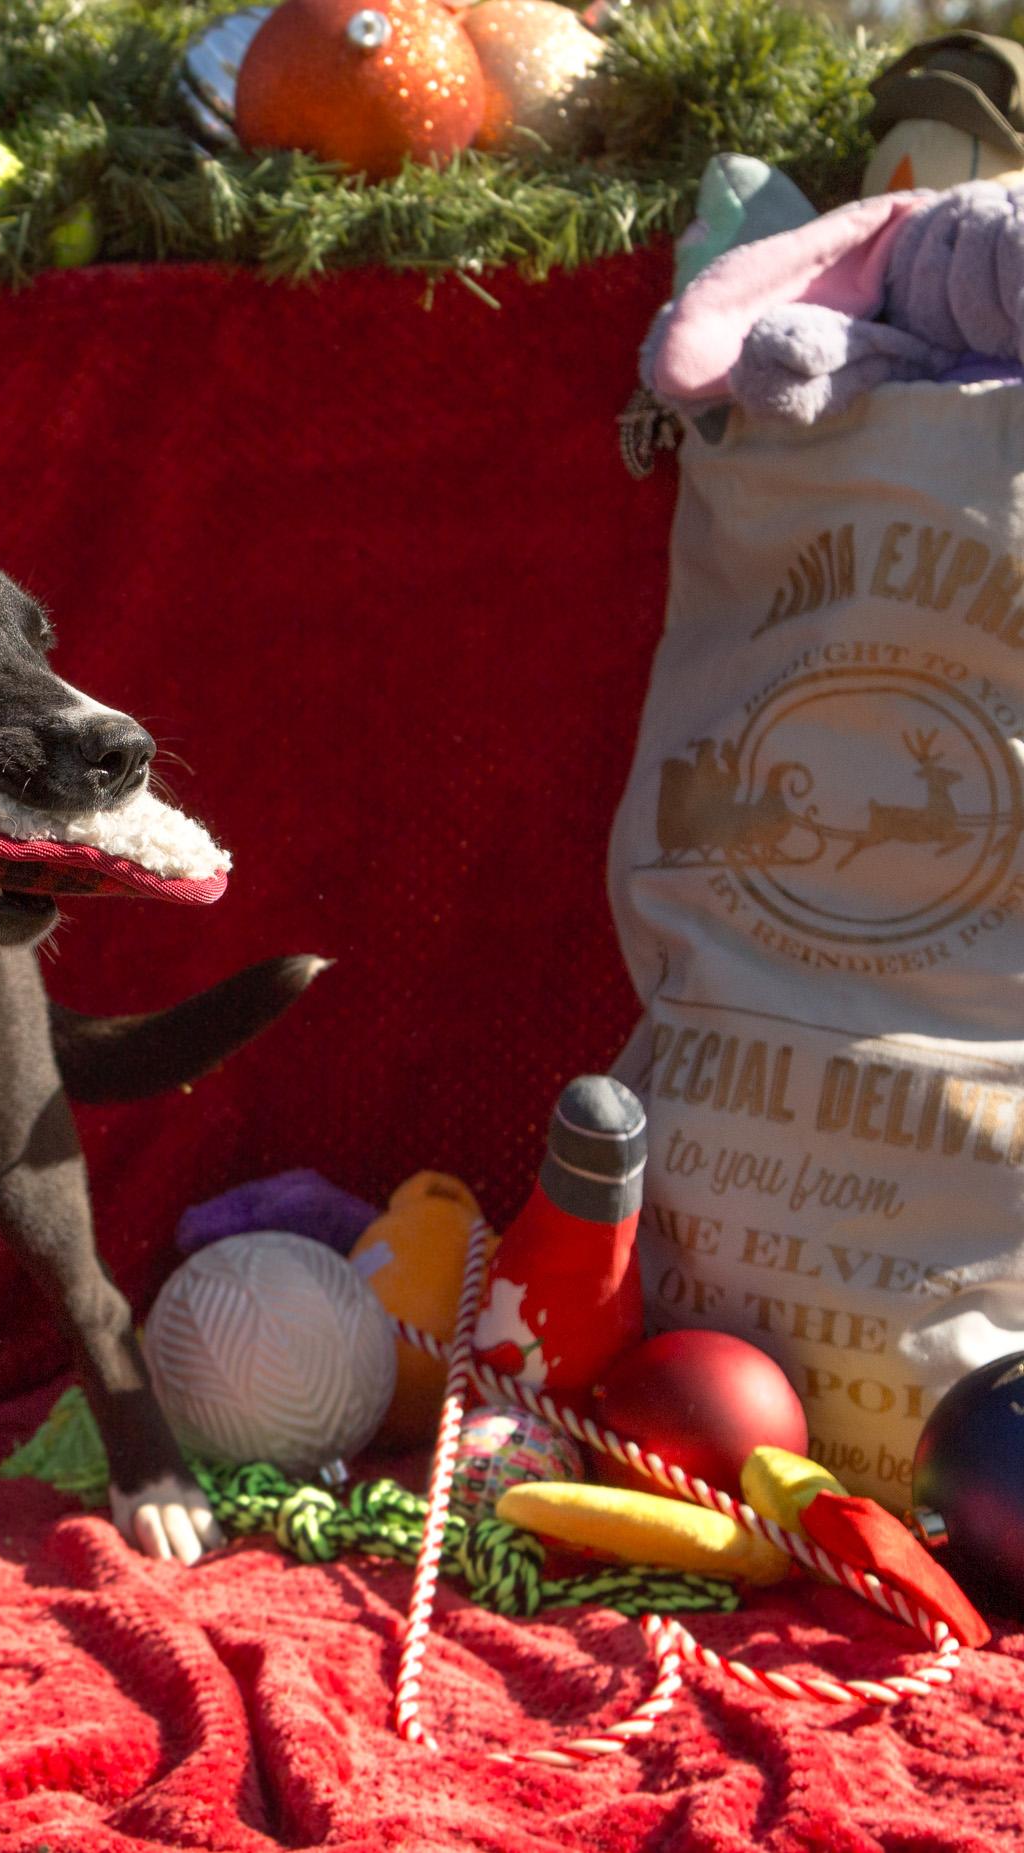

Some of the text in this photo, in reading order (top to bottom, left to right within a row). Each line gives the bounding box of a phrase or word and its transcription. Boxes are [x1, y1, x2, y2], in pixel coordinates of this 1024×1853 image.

[921, 651, 969, 681] TO
[751, 919, 951, 974] REINDEER
[640, 1024, 796, 1122] PECIAL
[665, 1129, 905, 1219] to you from
[740, 1229, 964, 1297] ELVES
[658, 1267, 888, 1350] OF THE
